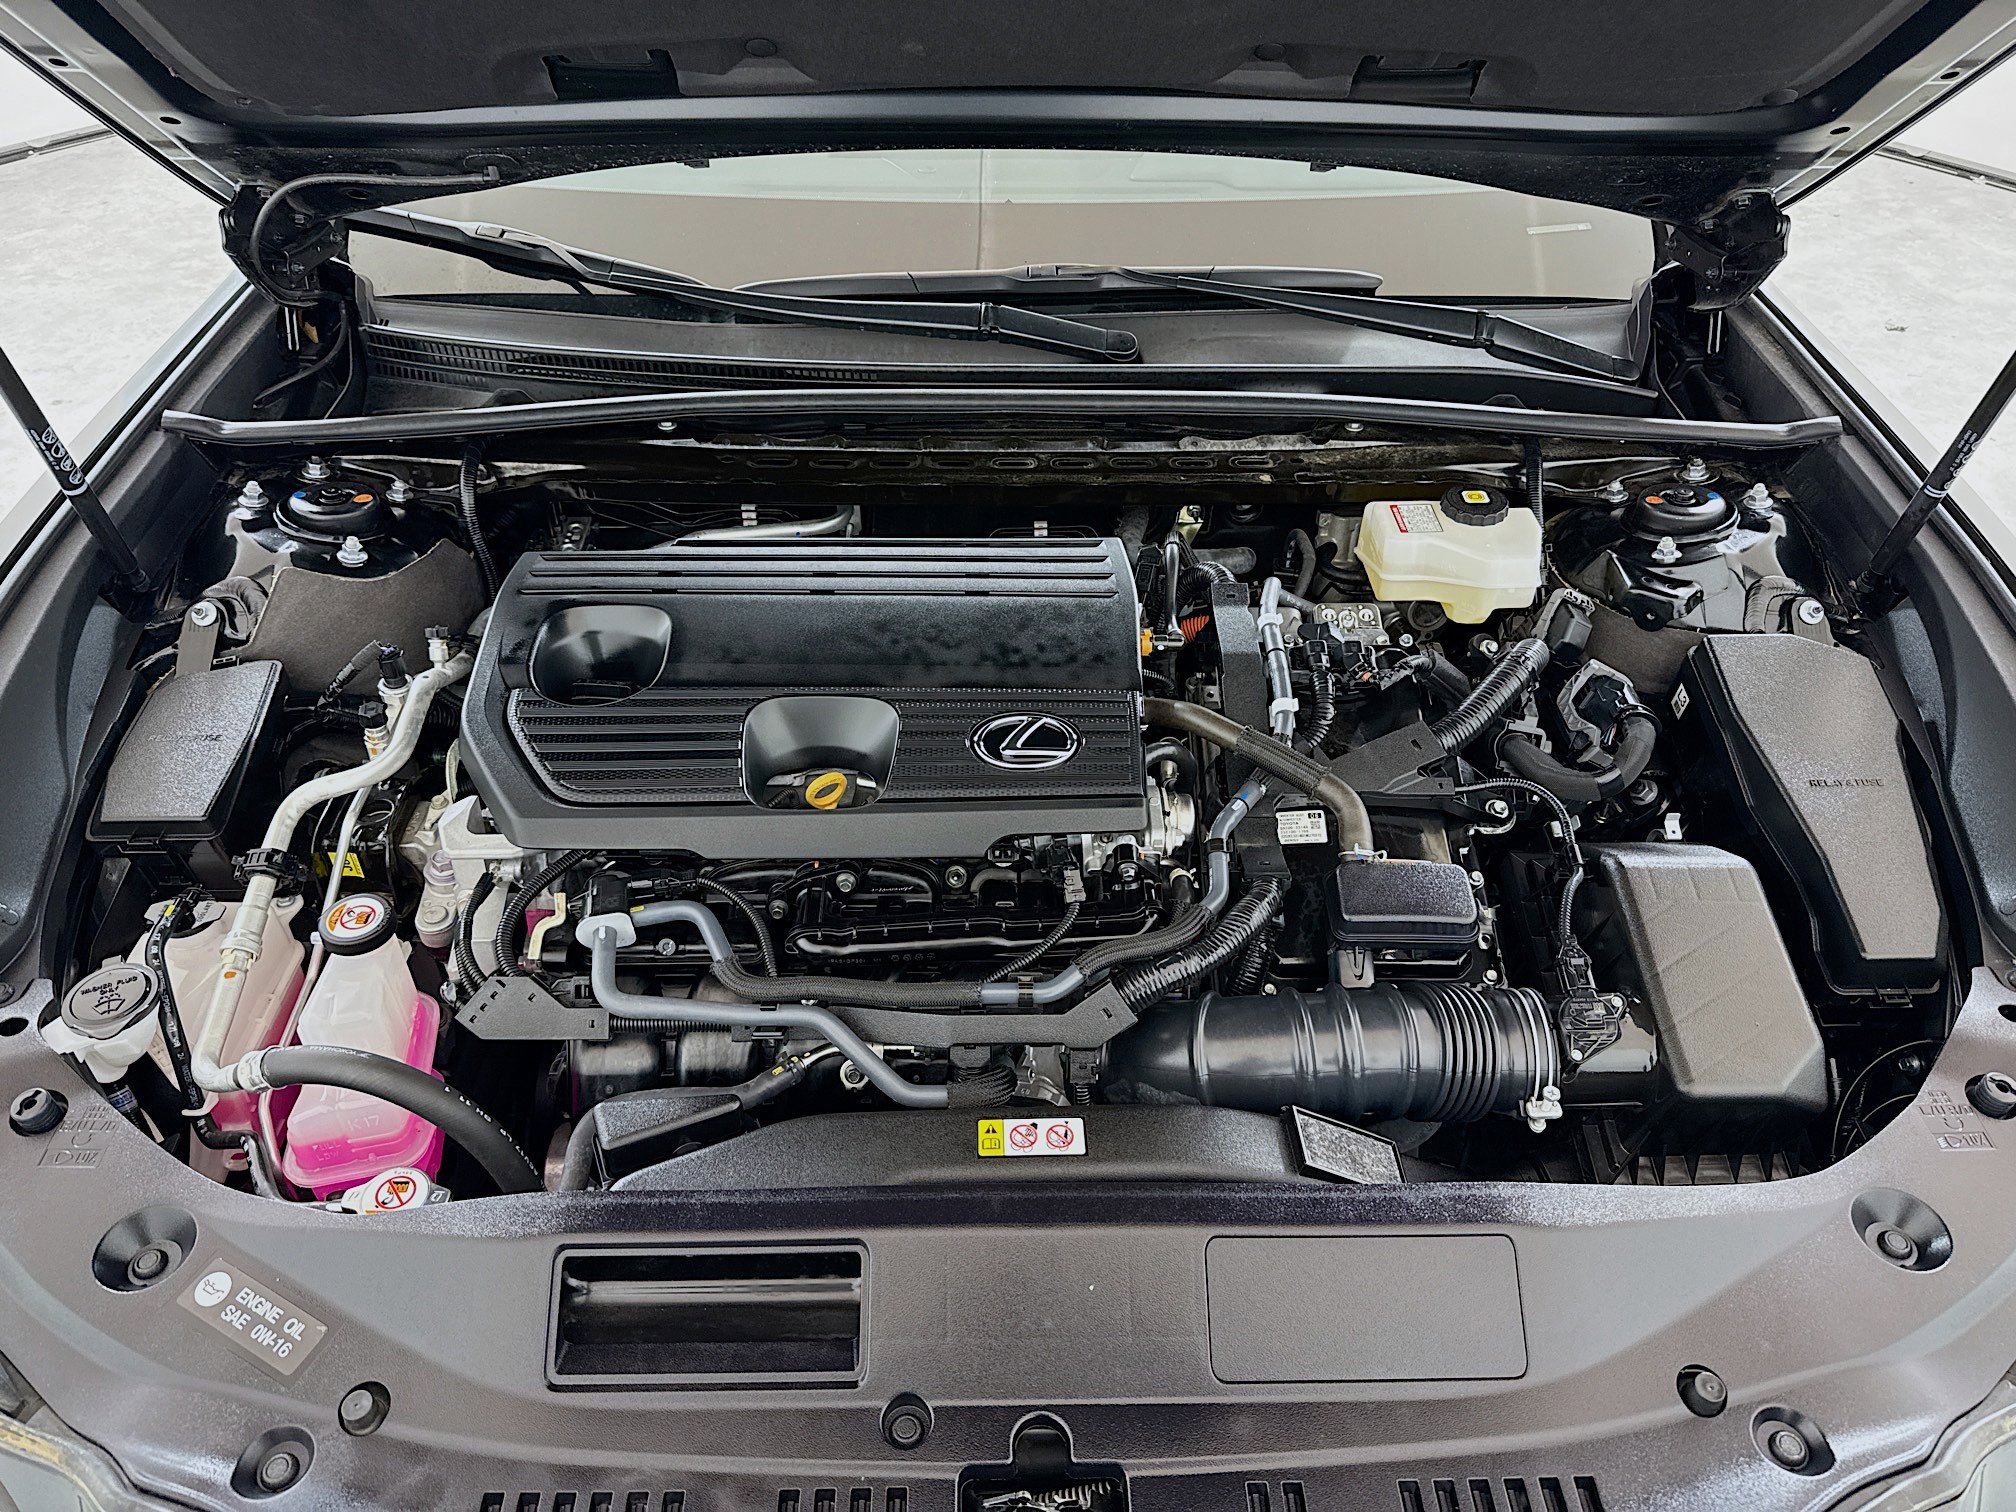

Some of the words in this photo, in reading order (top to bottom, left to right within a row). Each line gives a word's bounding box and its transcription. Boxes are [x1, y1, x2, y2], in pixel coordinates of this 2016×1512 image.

[220, 1304, 252, 1331] SAE
[250, 1323, 293, 1358] 0W-16
[235, 1287, 284, 1325] ENGINE
[283, 1317, 306, 1342] OIL
